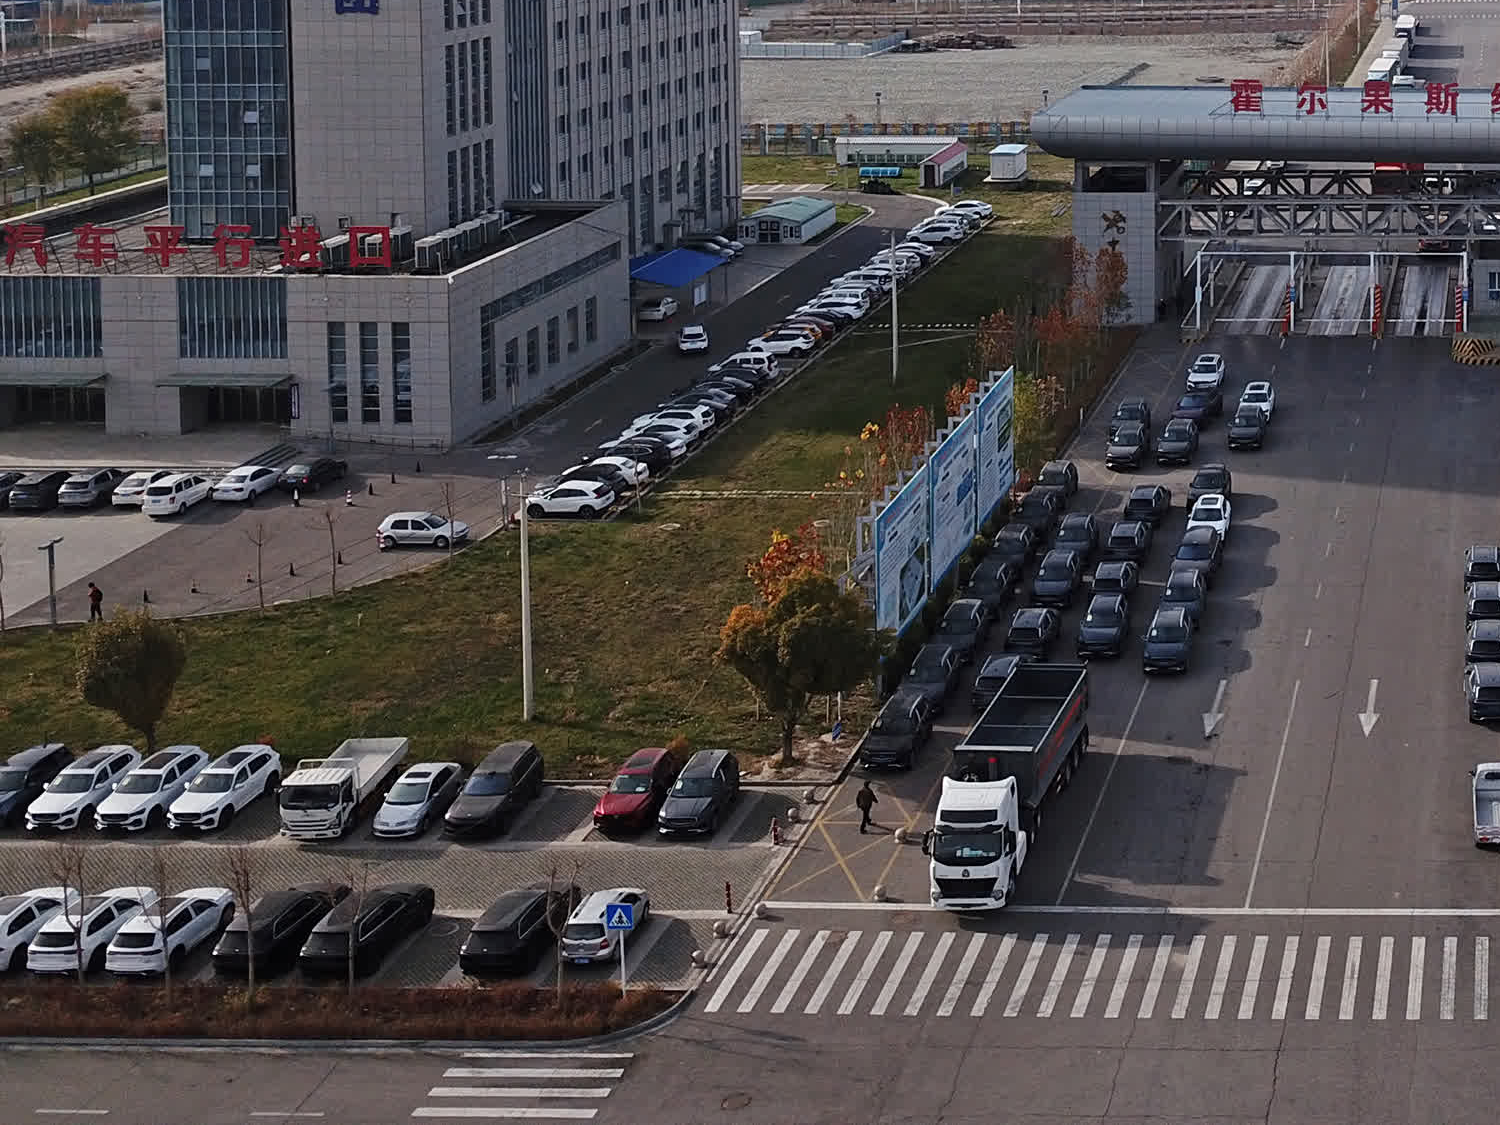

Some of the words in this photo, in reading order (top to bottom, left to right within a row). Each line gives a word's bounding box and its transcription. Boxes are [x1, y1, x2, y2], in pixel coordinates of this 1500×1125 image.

[3, 222, 392, 269] 汽车平行进口
